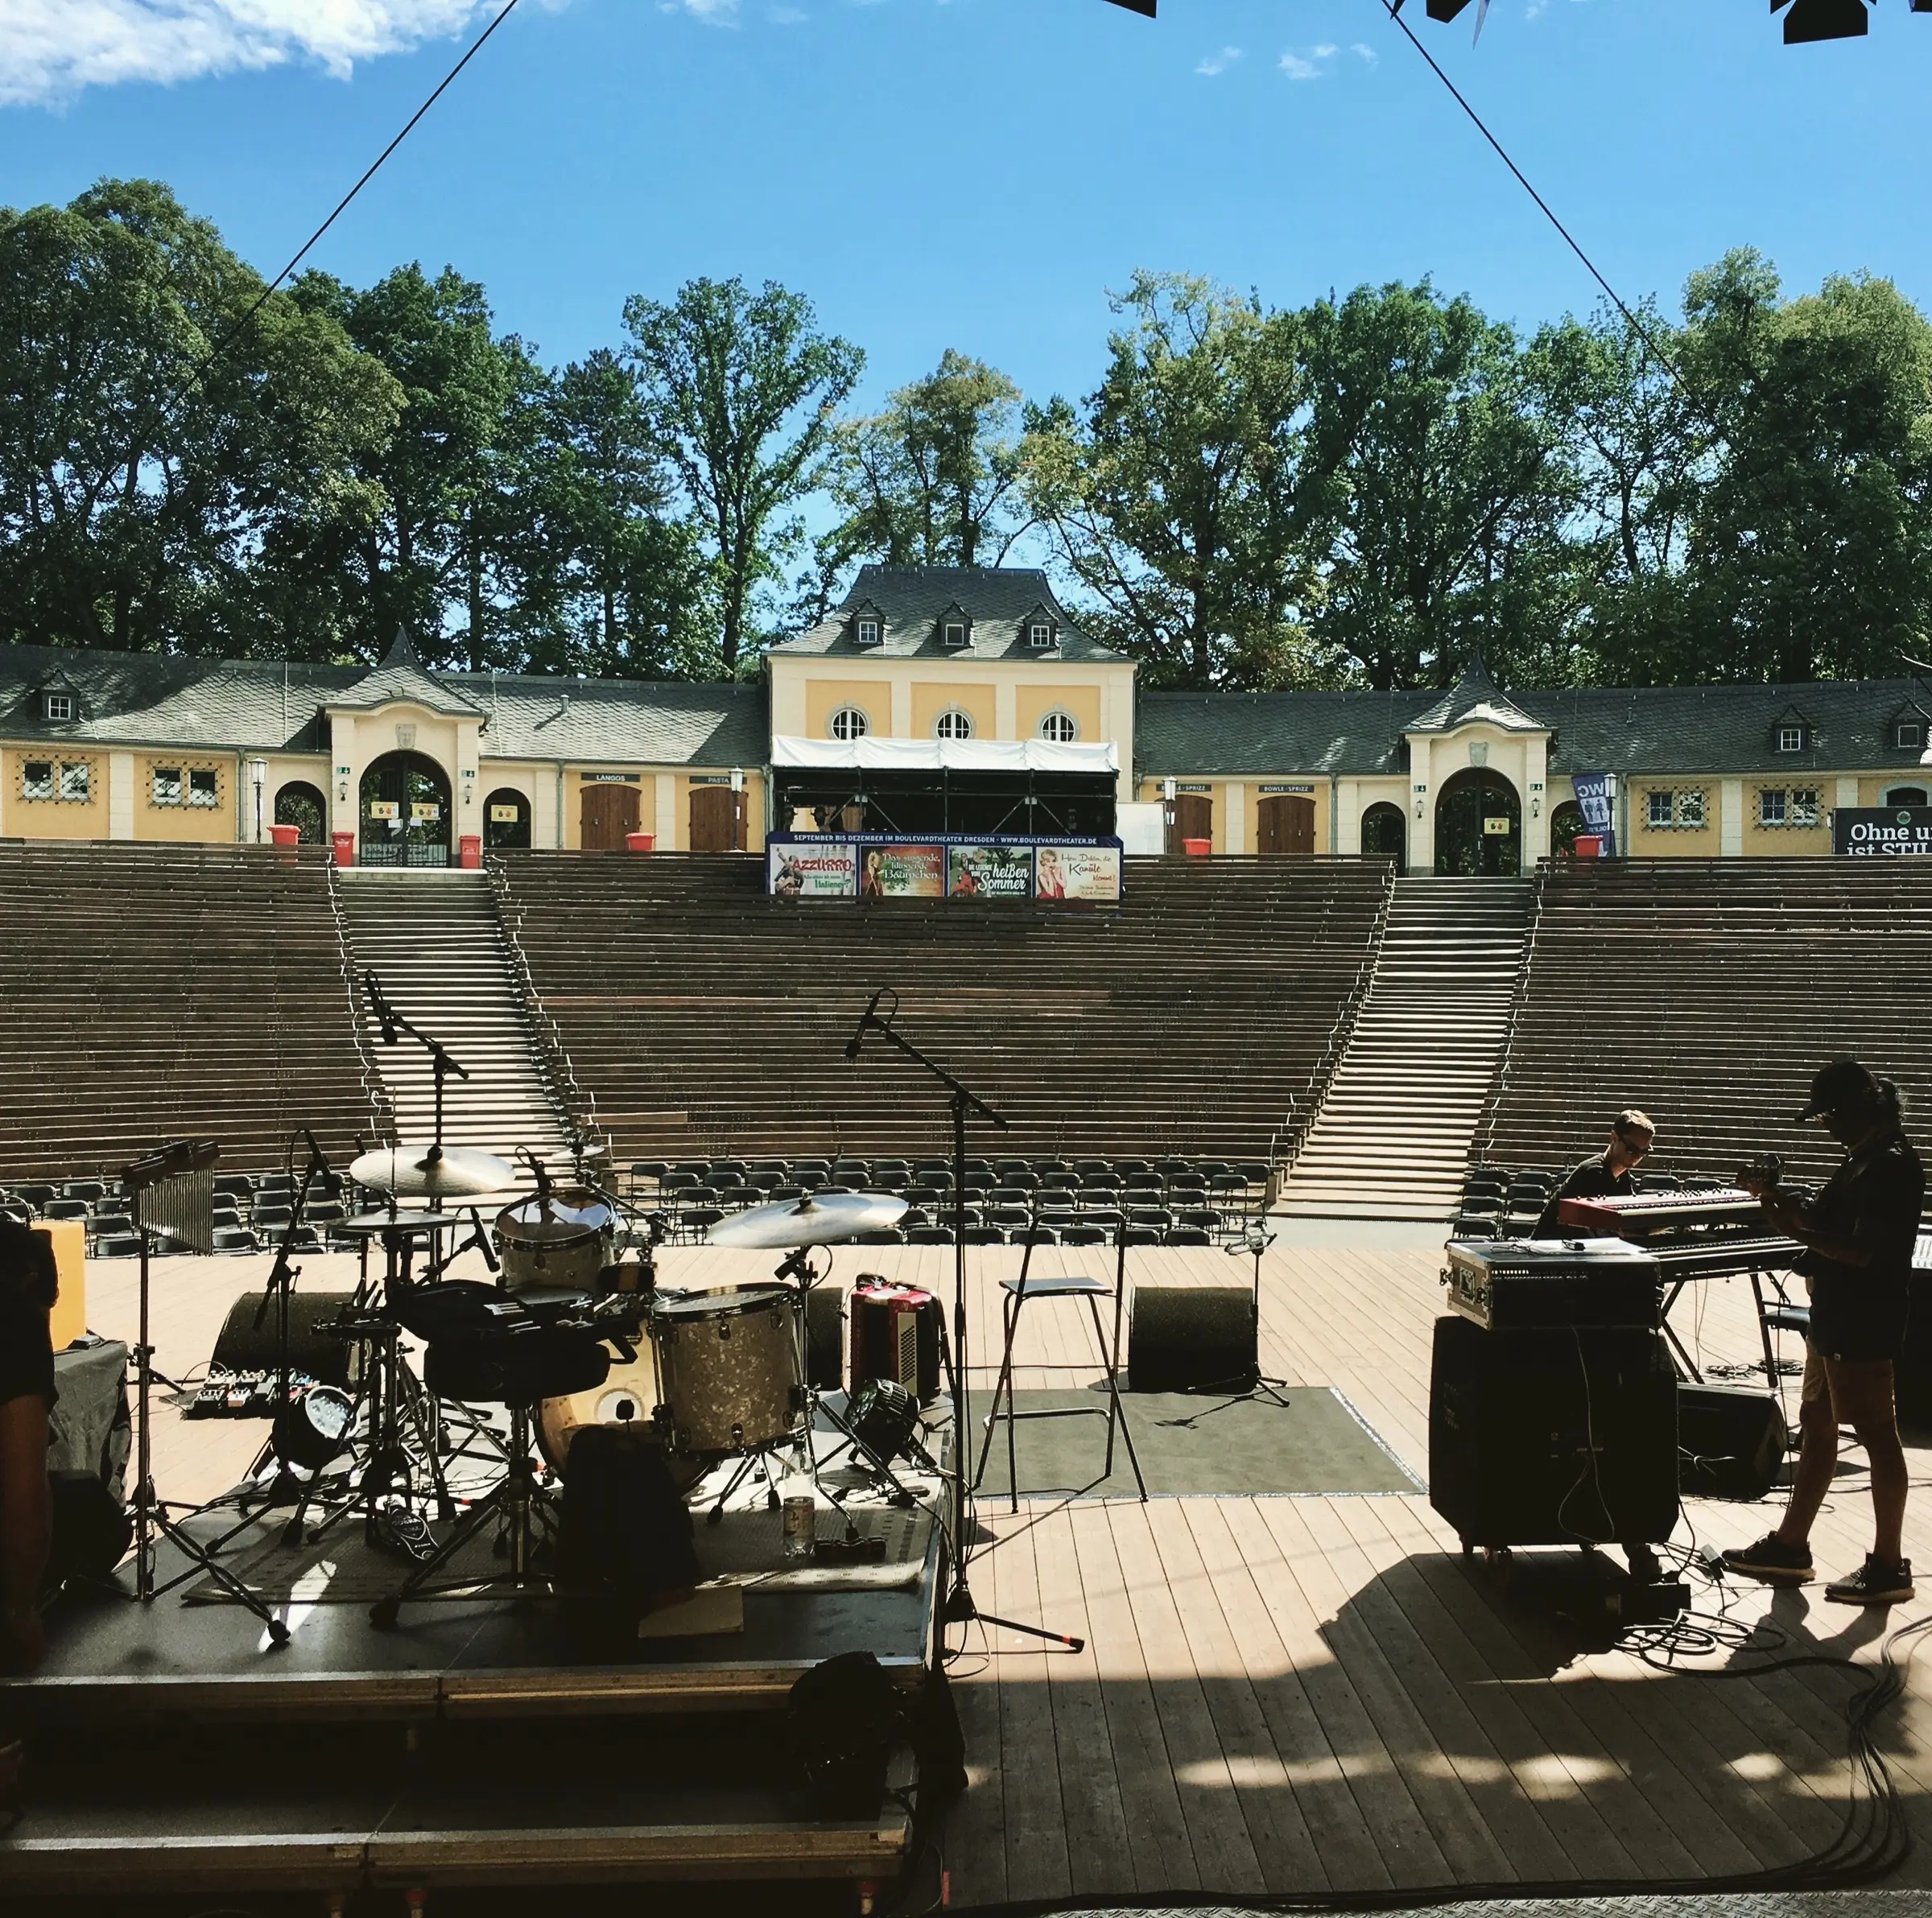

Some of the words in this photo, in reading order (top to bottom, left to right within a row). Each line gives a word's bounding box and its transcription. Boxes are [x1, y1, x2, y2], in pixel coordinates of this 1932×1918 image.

[1851, 823, 1909, 841] Ohne
[1915, 827, 1932, 840] u
[1847, 843, 1875, 856] ist
[792, 858, 852, 872] AZZURRO
[993, 863, 1030, 879] heißen
[1069, 863, 1101, 876] Kanüle
[977, 872, 1026, 891] Sommer
